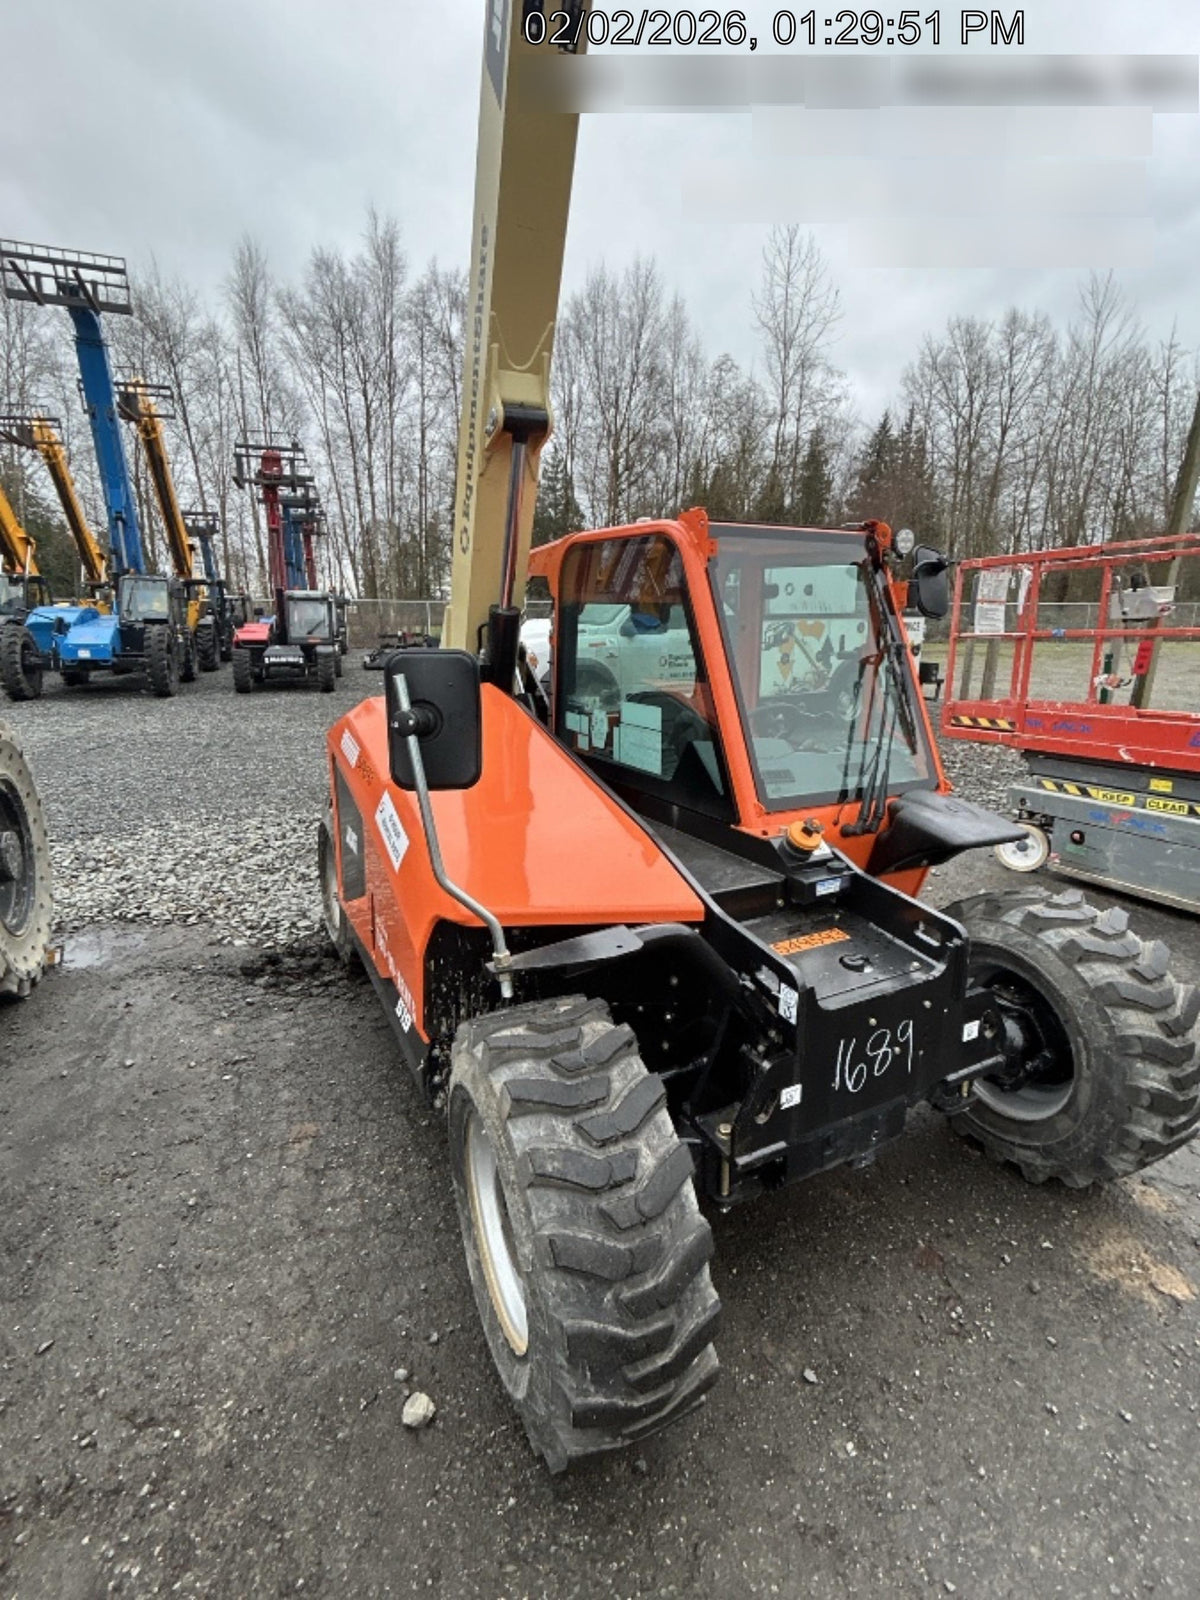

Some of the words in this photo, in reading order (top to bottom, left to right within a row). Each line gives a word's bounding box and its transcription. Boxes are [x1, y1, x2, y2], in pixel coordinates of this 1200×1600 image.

[1102, 792, 1130, 803] KEEP
[1148, 799, 1186, 813] CLEAR
[834, 1019, 914, 1093] 1689
